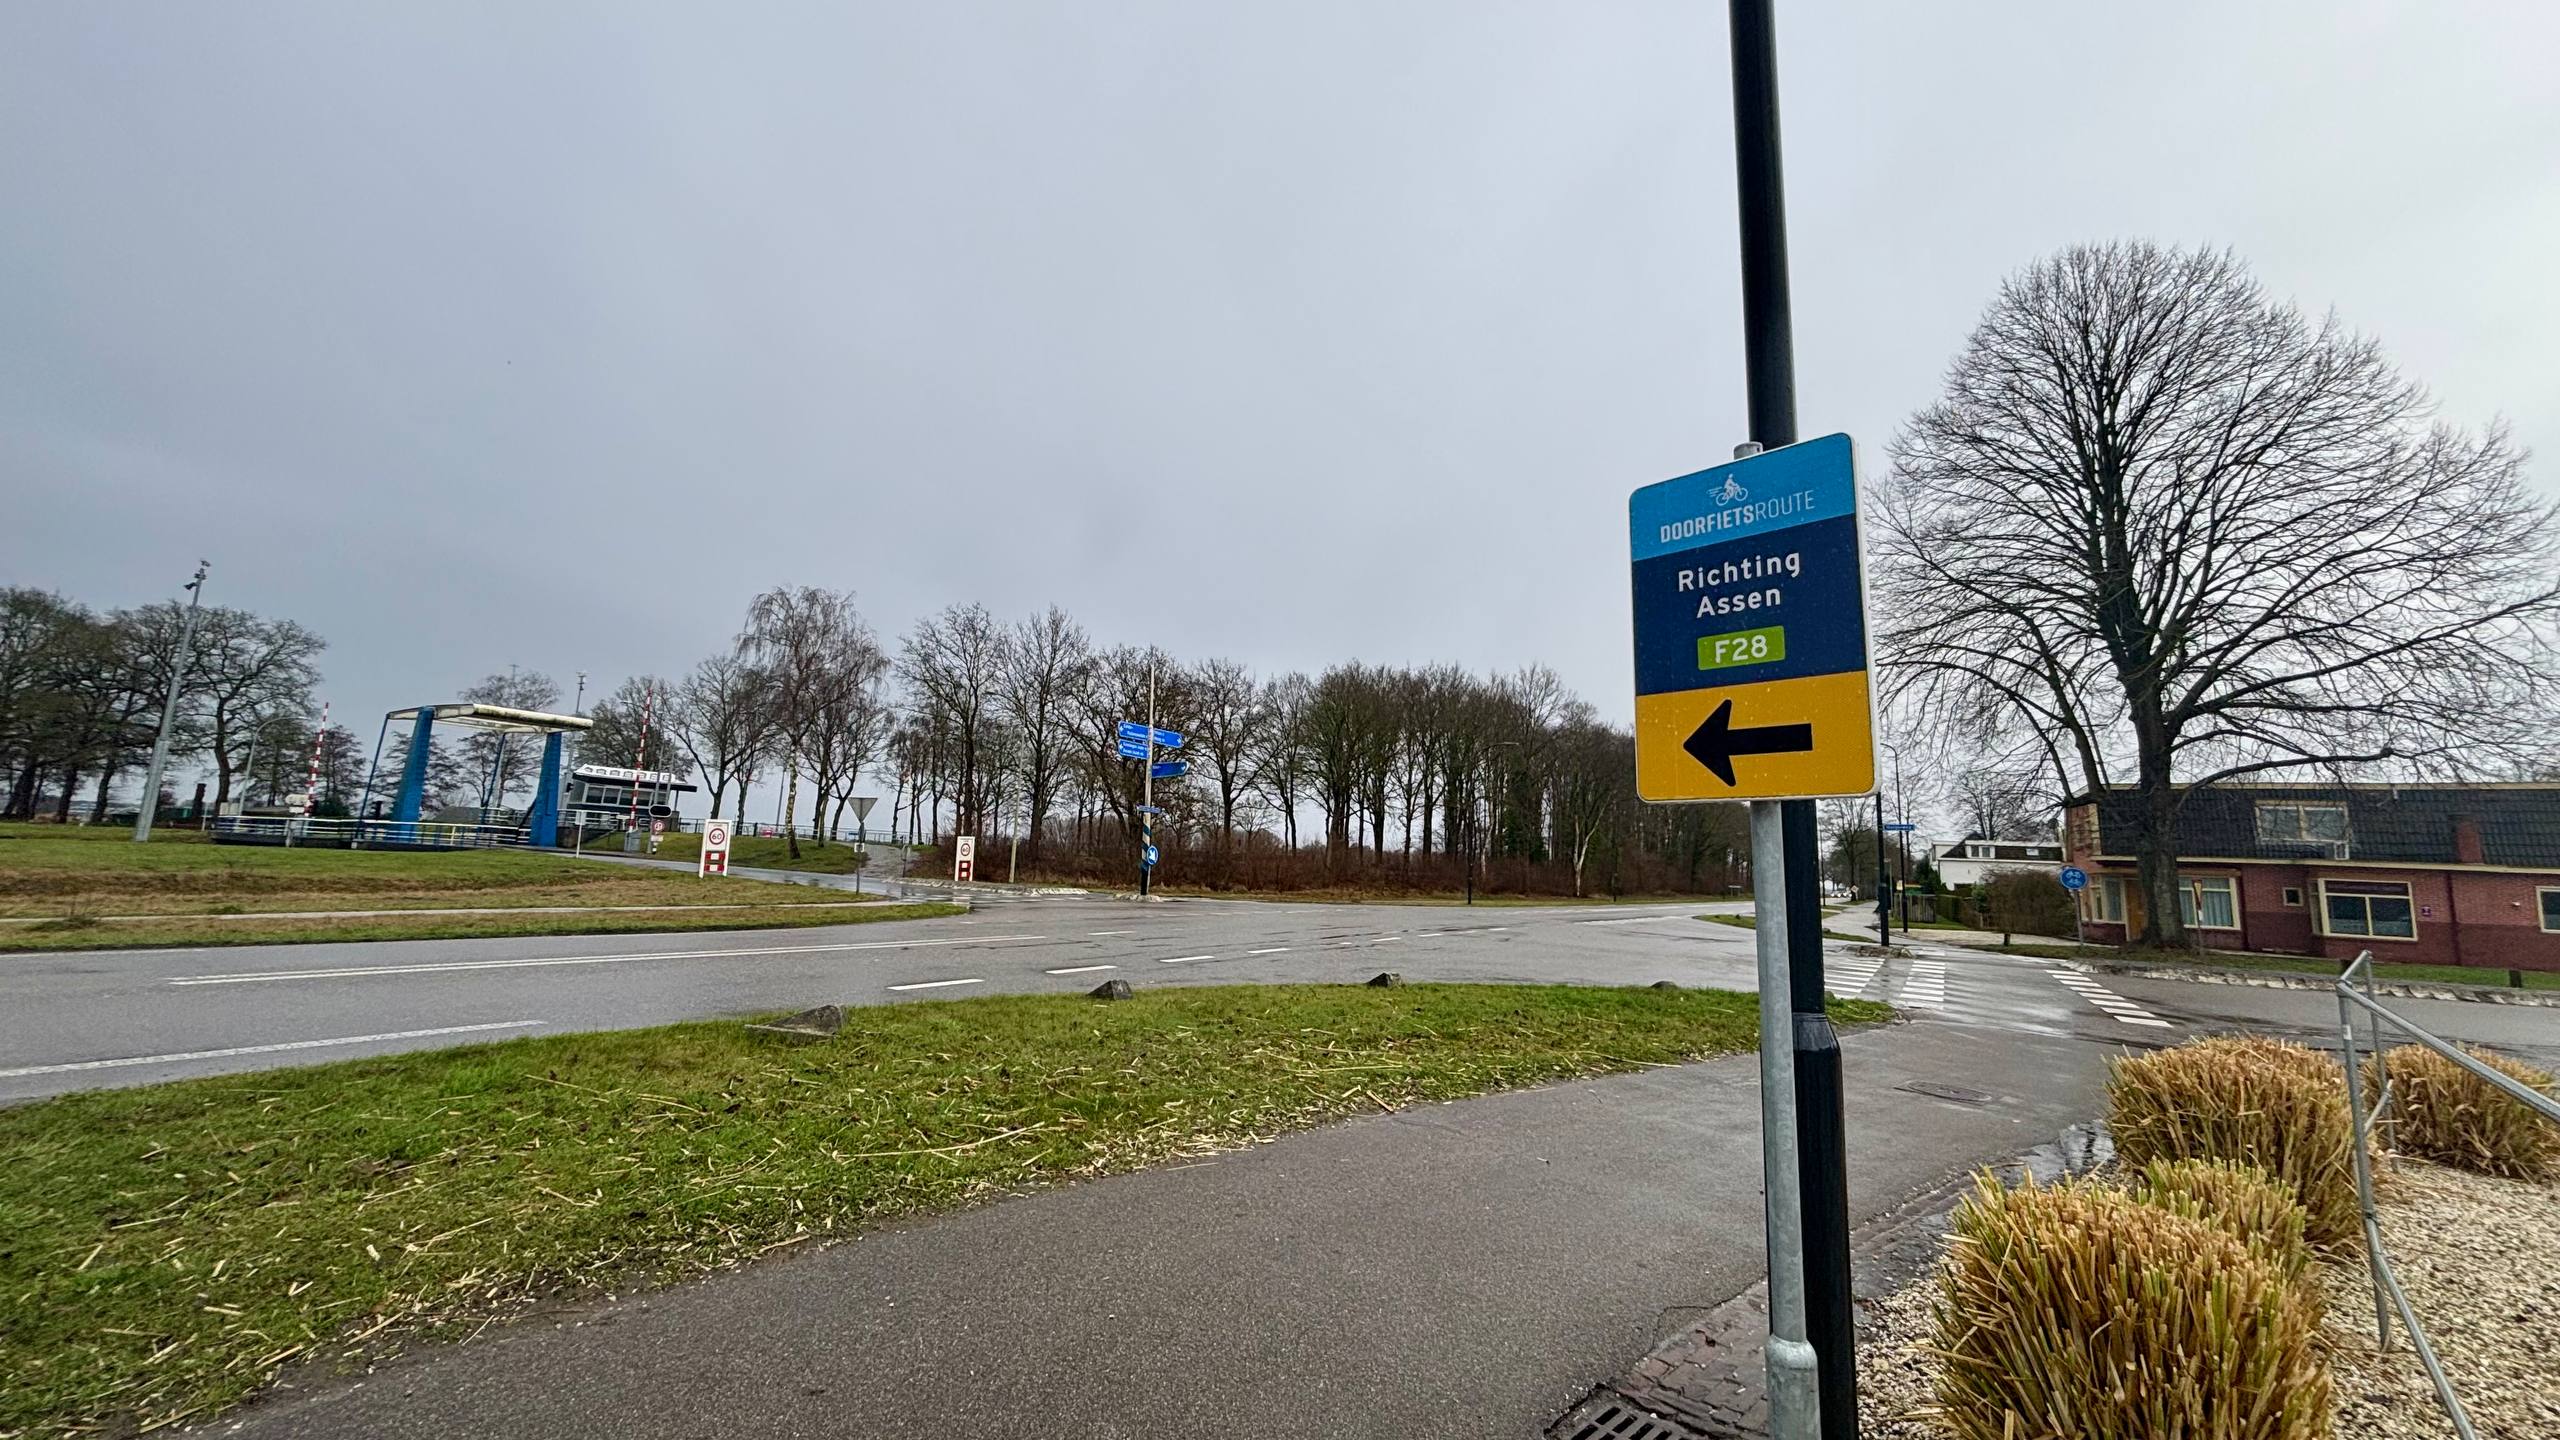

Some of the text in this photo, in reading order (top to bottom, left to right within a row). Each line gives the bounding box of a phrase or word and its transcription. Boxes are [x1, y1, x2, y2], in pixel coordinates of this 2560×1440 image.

[1660, 490, 1815, 543] DOORFIETSROUTE
[1679, 552, 1801, 592] Richting
[1697, 588, 1781, 618] Assen
[1715, 635, 1767, 663] F28
